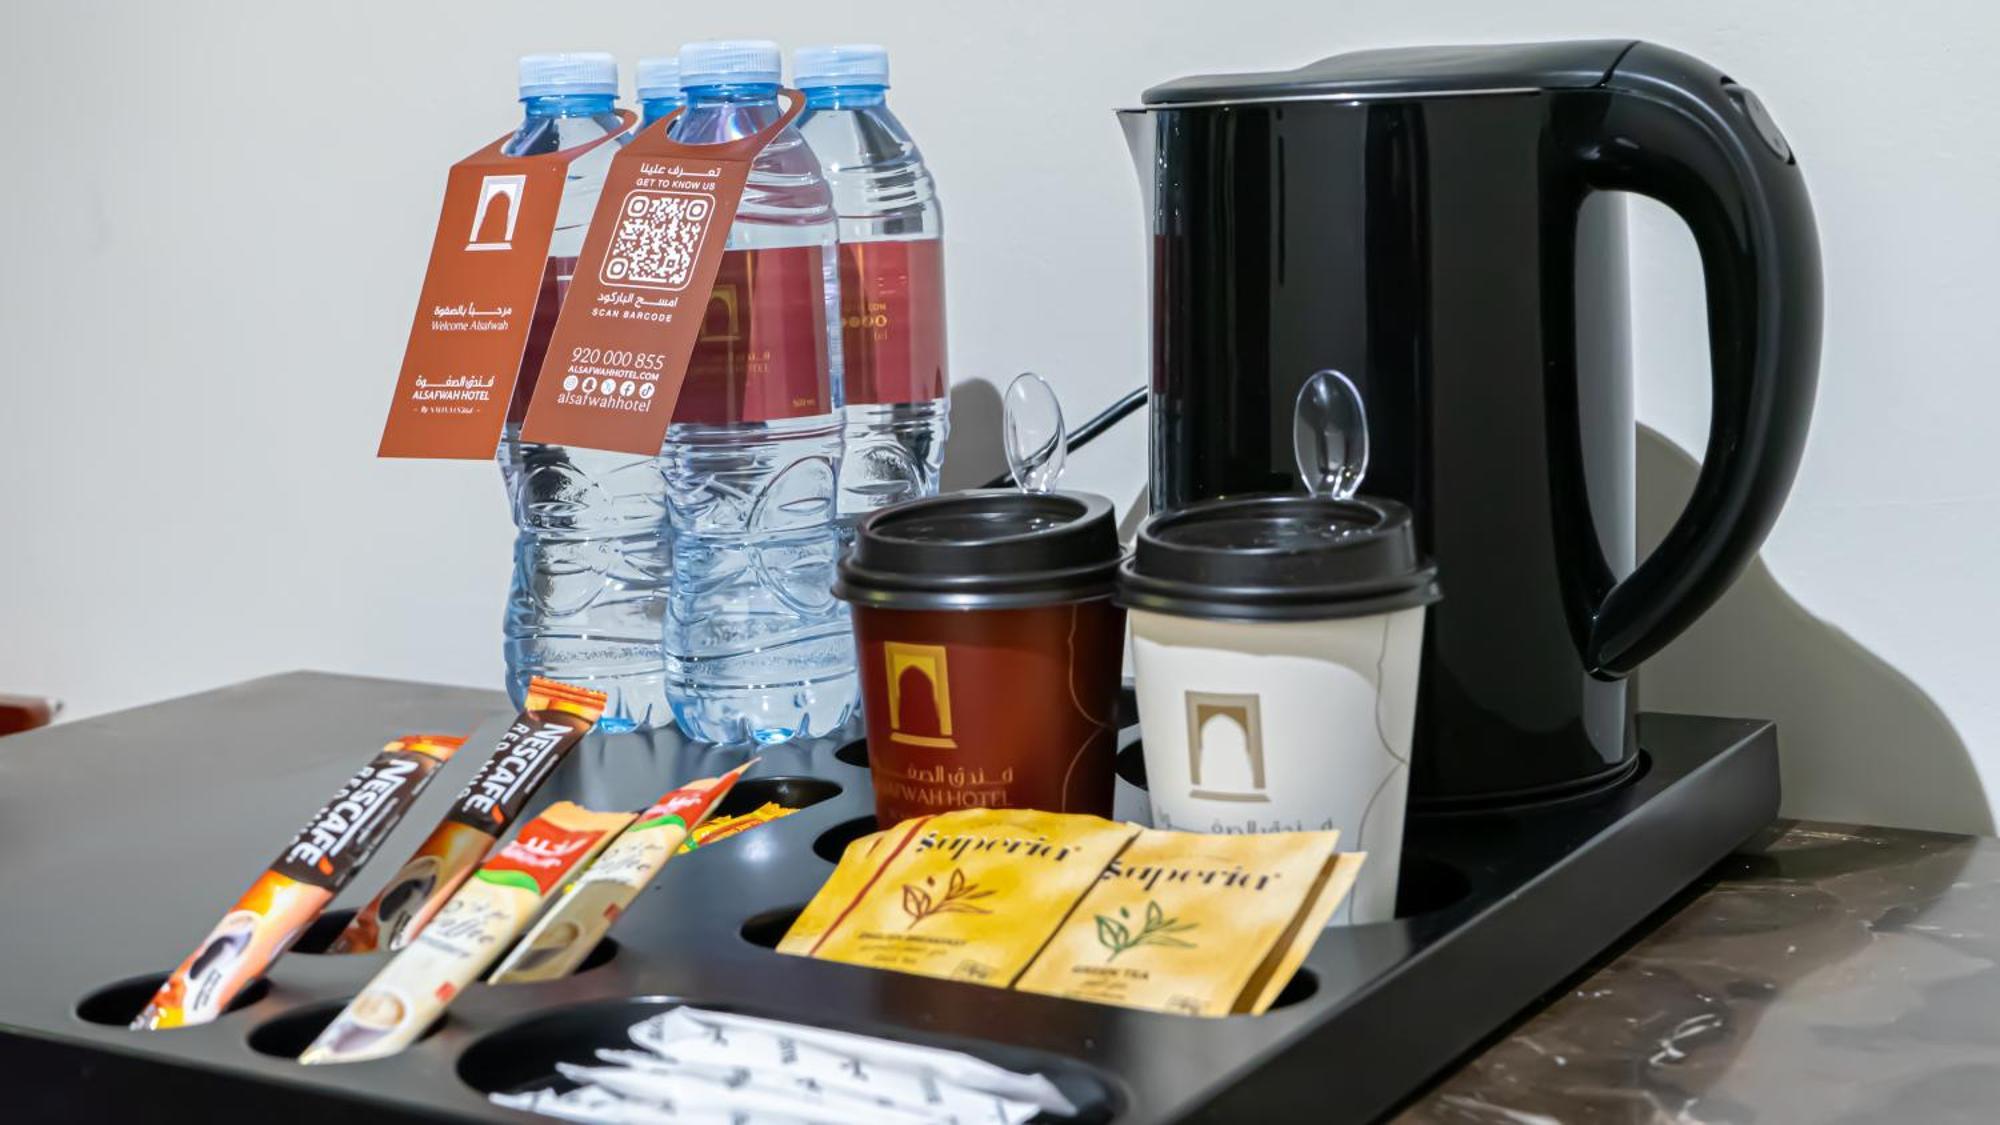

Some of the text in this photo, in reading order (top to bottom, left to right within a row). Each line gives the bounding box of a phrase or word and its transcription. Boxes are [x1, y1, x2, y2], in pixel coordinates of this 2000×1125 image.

[640, 162, 666, 176] علينا
[635, 178, 716, 191] GET TO KNOW US
[597, 291, 635, 306] الباركود
[591, 307, 673, 323] SCAN BARCODE
[431, 318, 510, 331] Welcome Alsafwah
[571, 347, 666, 370] 920 000 855
[567, 365, 660, 382] ALSAFWAHHOTEL.COM
[411, 390, 491, 401] ALSAFWAH HOTEL
[557, 391, 652, 413] alsafwahhotel
[915, 832, 1082, 862] Superior
[1100, 860, 1281, 892] Superior
